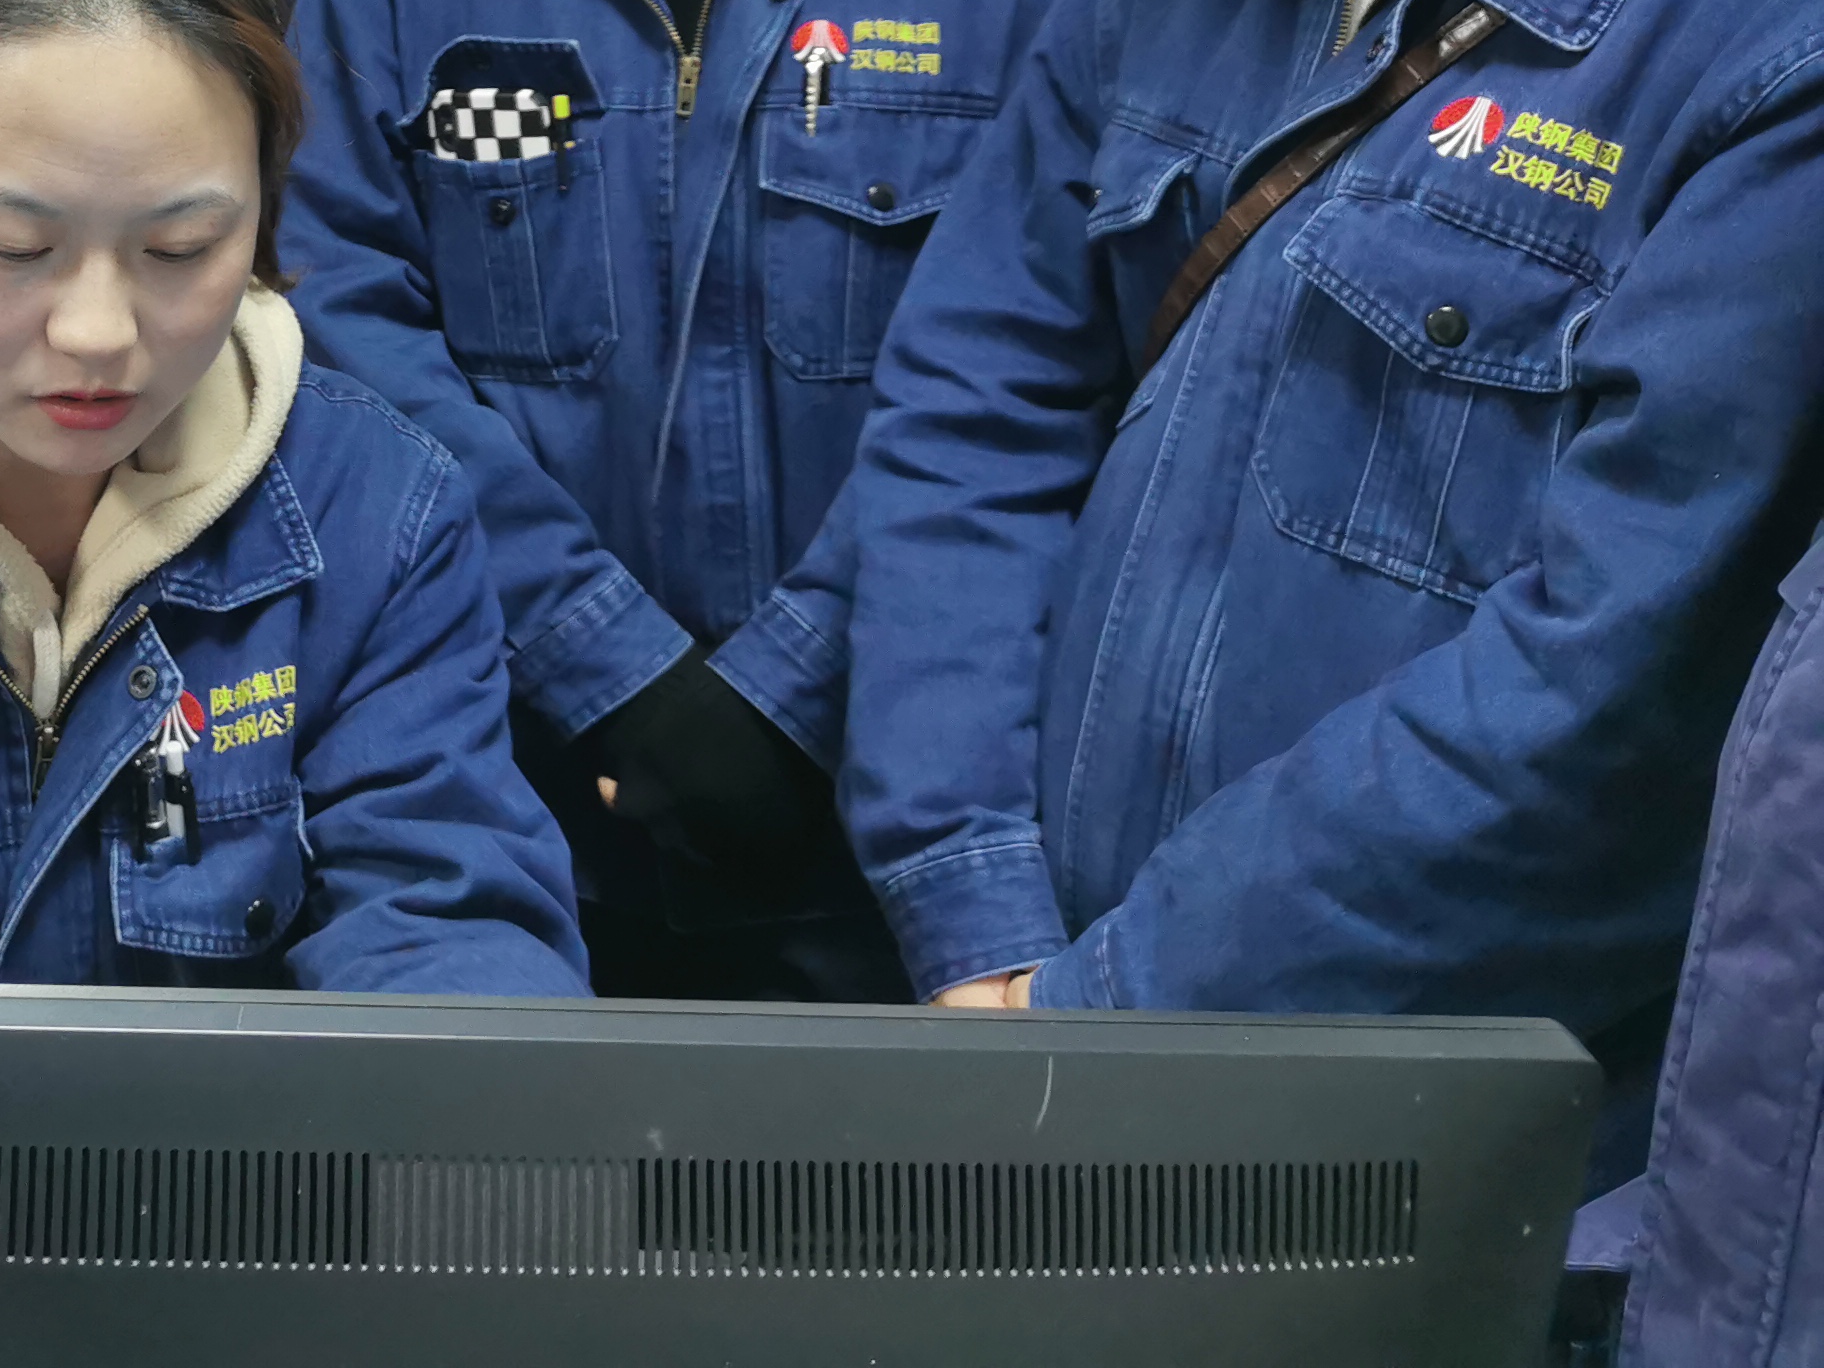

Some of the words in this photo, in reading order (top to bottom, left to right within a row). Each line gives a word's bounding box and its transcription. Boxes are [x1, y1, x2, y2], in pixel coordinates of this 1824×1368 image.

[852, 19, 941, 44] 陕钢集团
[849, 48, 942, 76] 汉钢公司
[1506, 111, 1624, 174] 陕钢集团
[1490, 144, 1613, 210] 汉钢公司
[209, 664, 297, 718] 陕钢集团
